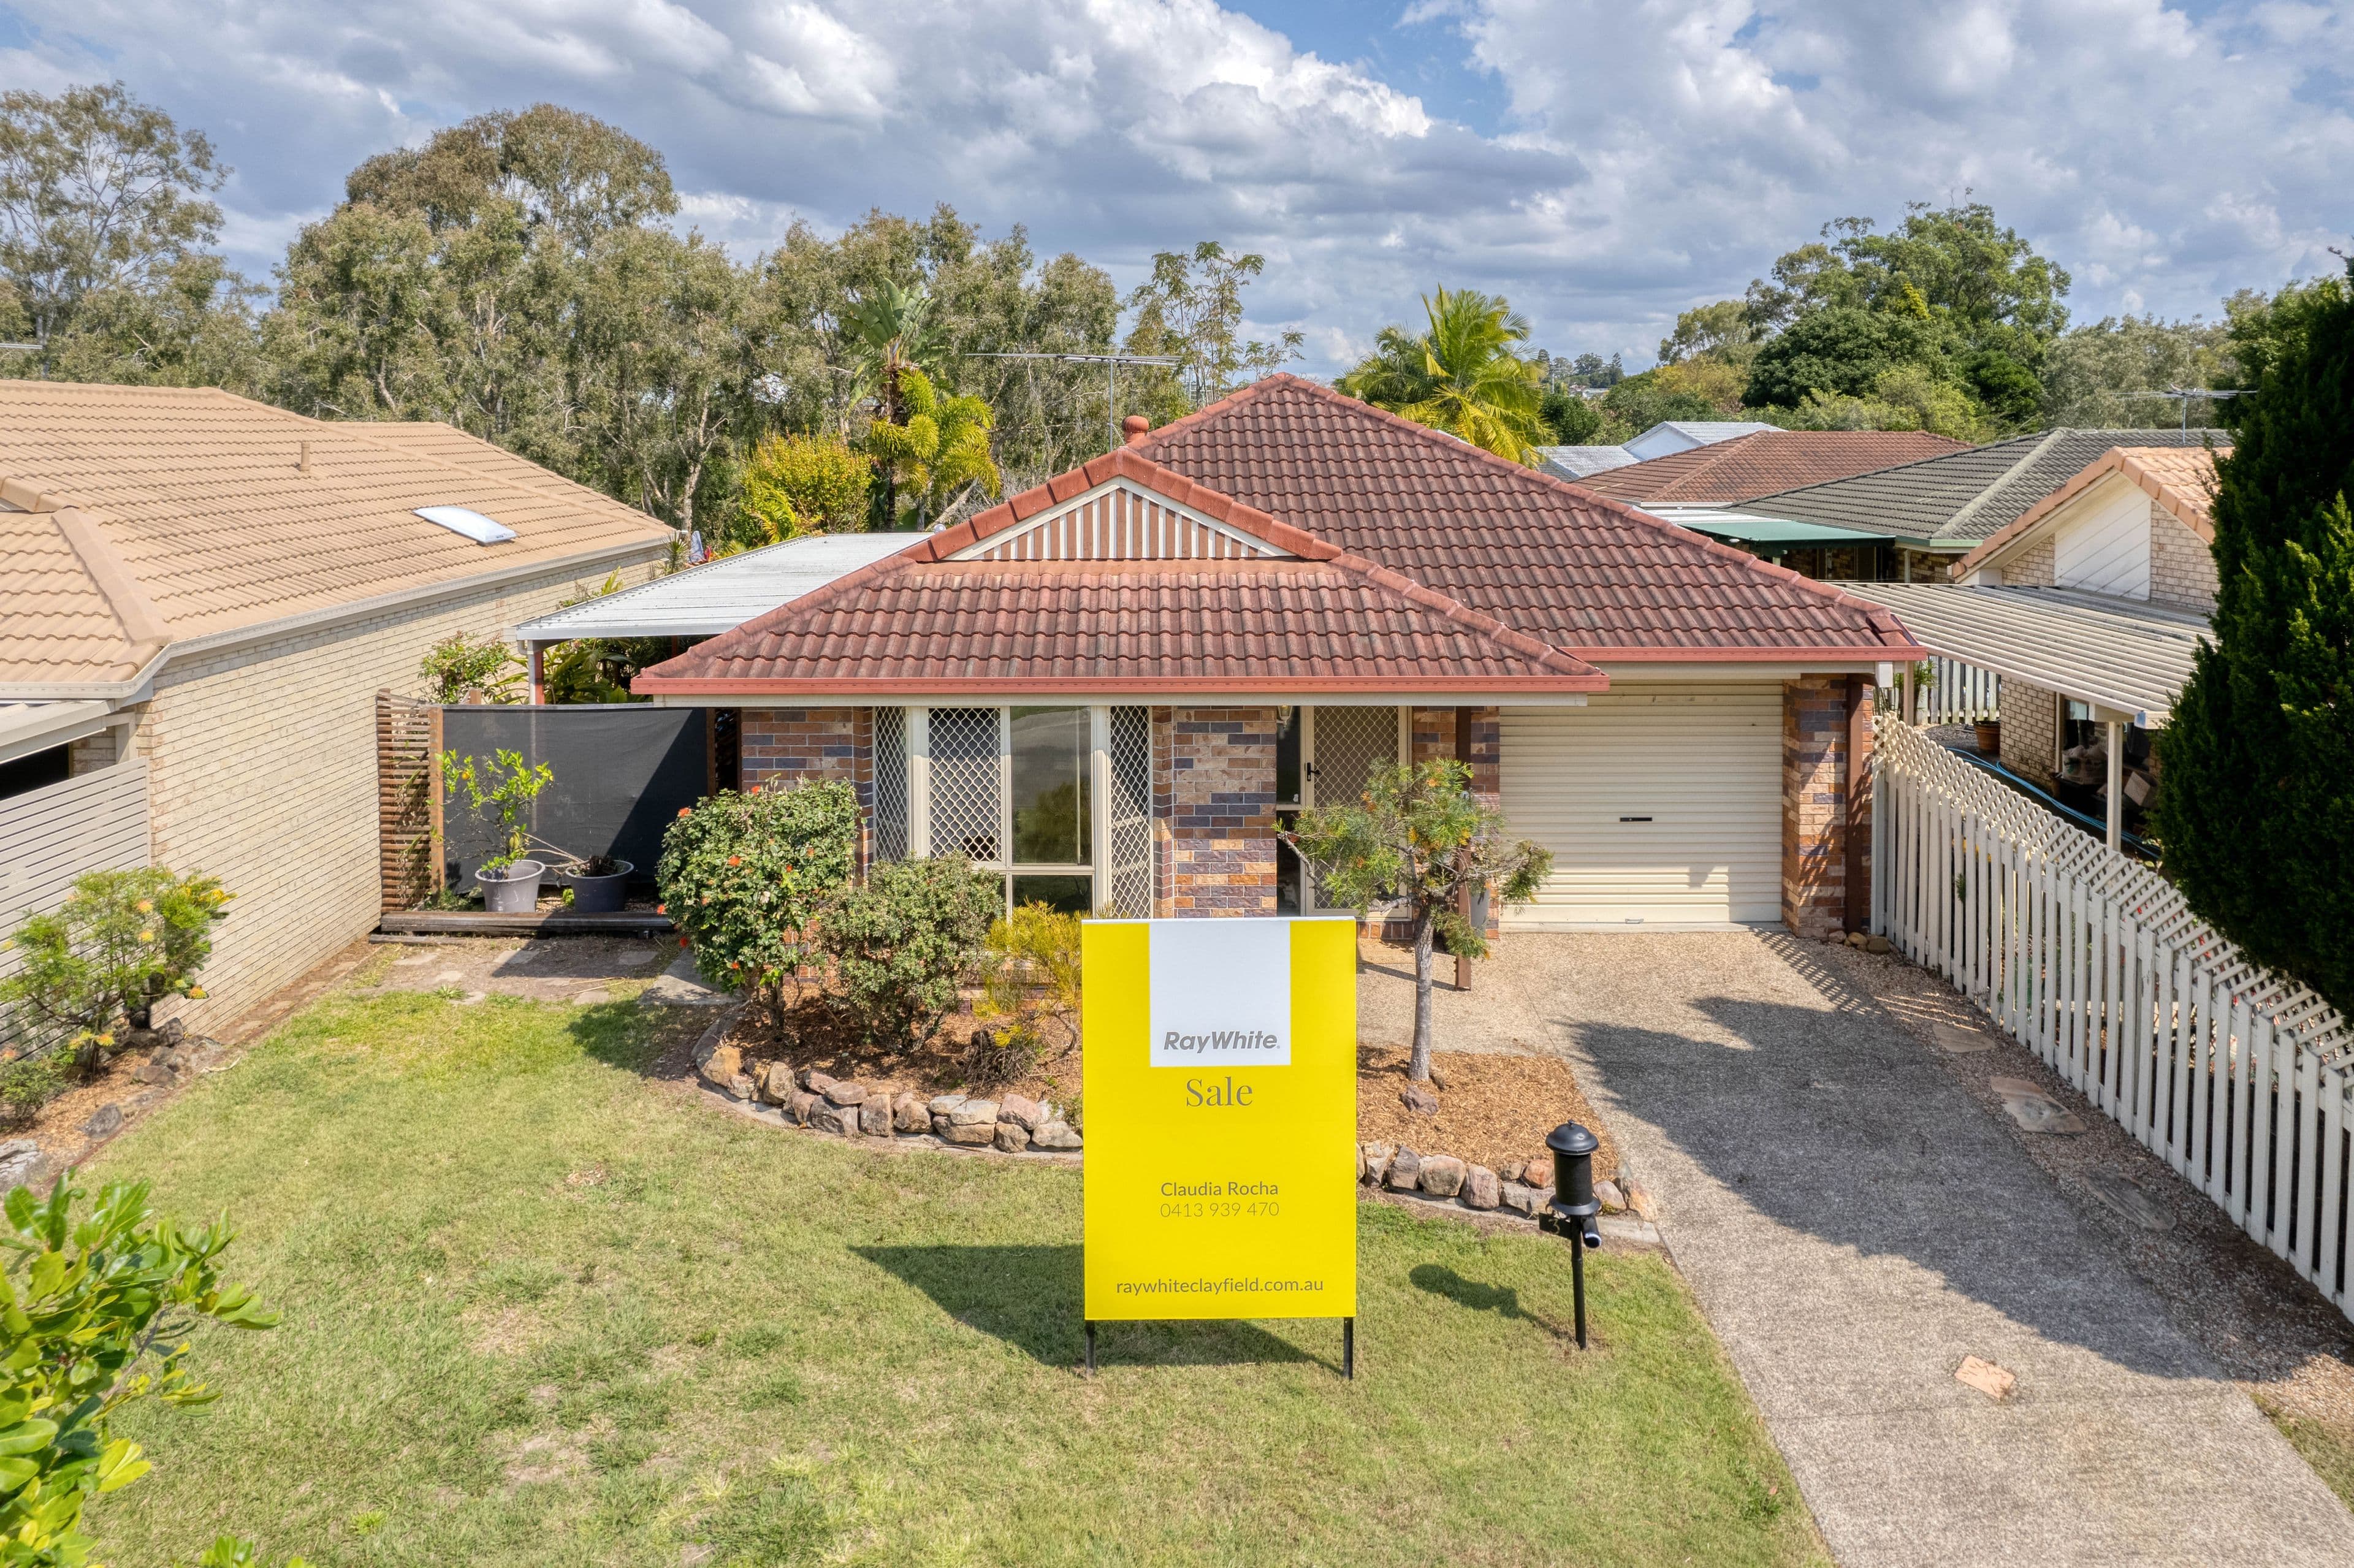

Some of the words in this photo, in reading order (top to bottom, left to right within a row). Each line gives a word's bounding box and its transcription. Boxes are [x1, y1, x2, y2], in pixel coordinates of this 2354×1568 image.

[1186, 1076, 1253, 1107] Sale
[1160, 1182, 1222, 1197] Claudia
[1228, 1181, 1278, 1195] Rocha
[1160, 1203, 1203, 1217] 0413
[1209, 1203, 1241, 1217] 939
[1247, 1202, 1279, 1216] 470
[1116, 1277, 1324, 1296] raywhiteclayfield.com.au
